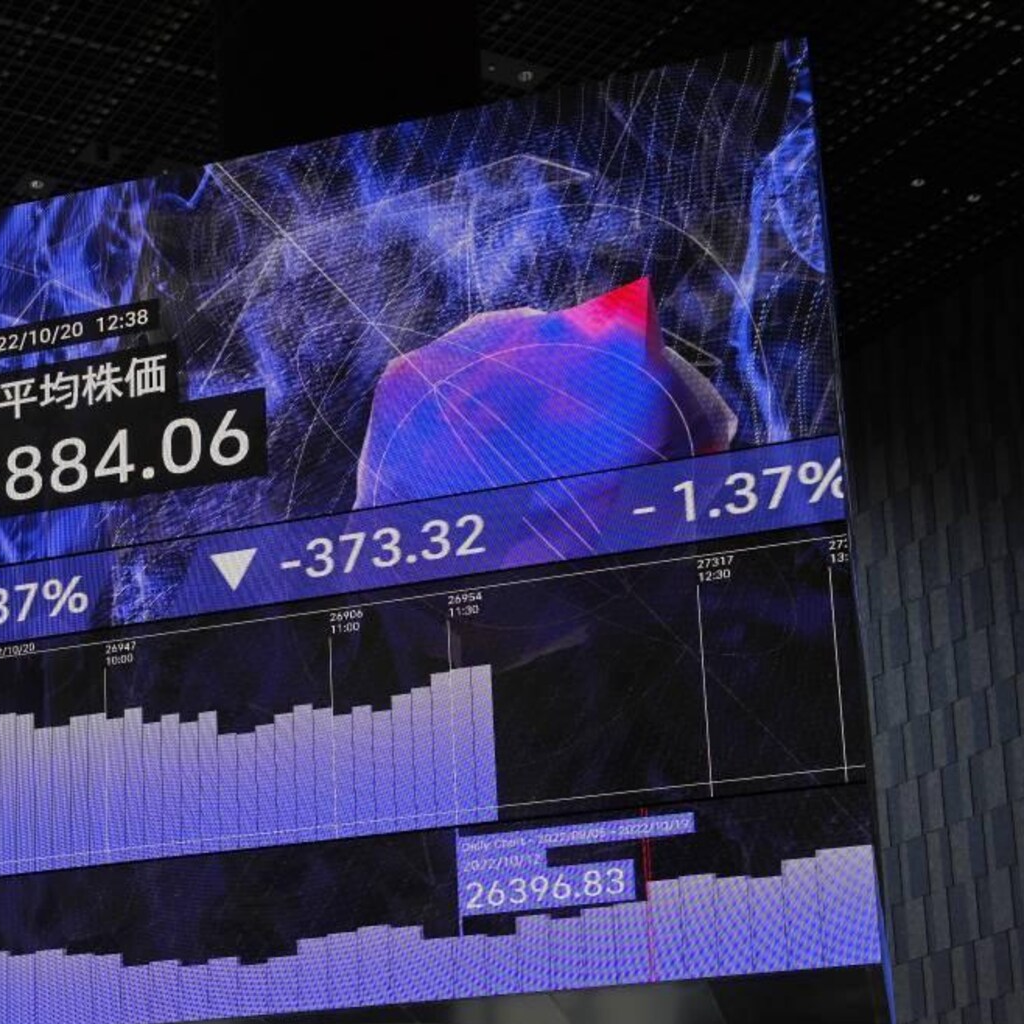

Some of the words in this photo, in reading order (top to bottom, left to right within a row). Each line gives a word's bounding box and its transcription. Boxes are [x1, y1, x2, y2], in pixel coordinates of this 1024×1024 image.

[95, 308, 149, 333] 12:38
[673, 457, 845, 522] 1.37%
[280, 514, 486, 578] -373.32
[696, 555, 734, 569] 27317
[698, 569, 731, 582] 12:30
[447, 591, 483, 605] 26954
[329, 609, 364, 622] 26906
[449, 604, 479, 618] 11:30
[330, 621, 361, 635] 11:00
[105, 641, 137, 654] 26947
[106, 653, 133, 667] 10:00
[467, 868, 625, 909] 26396.83
